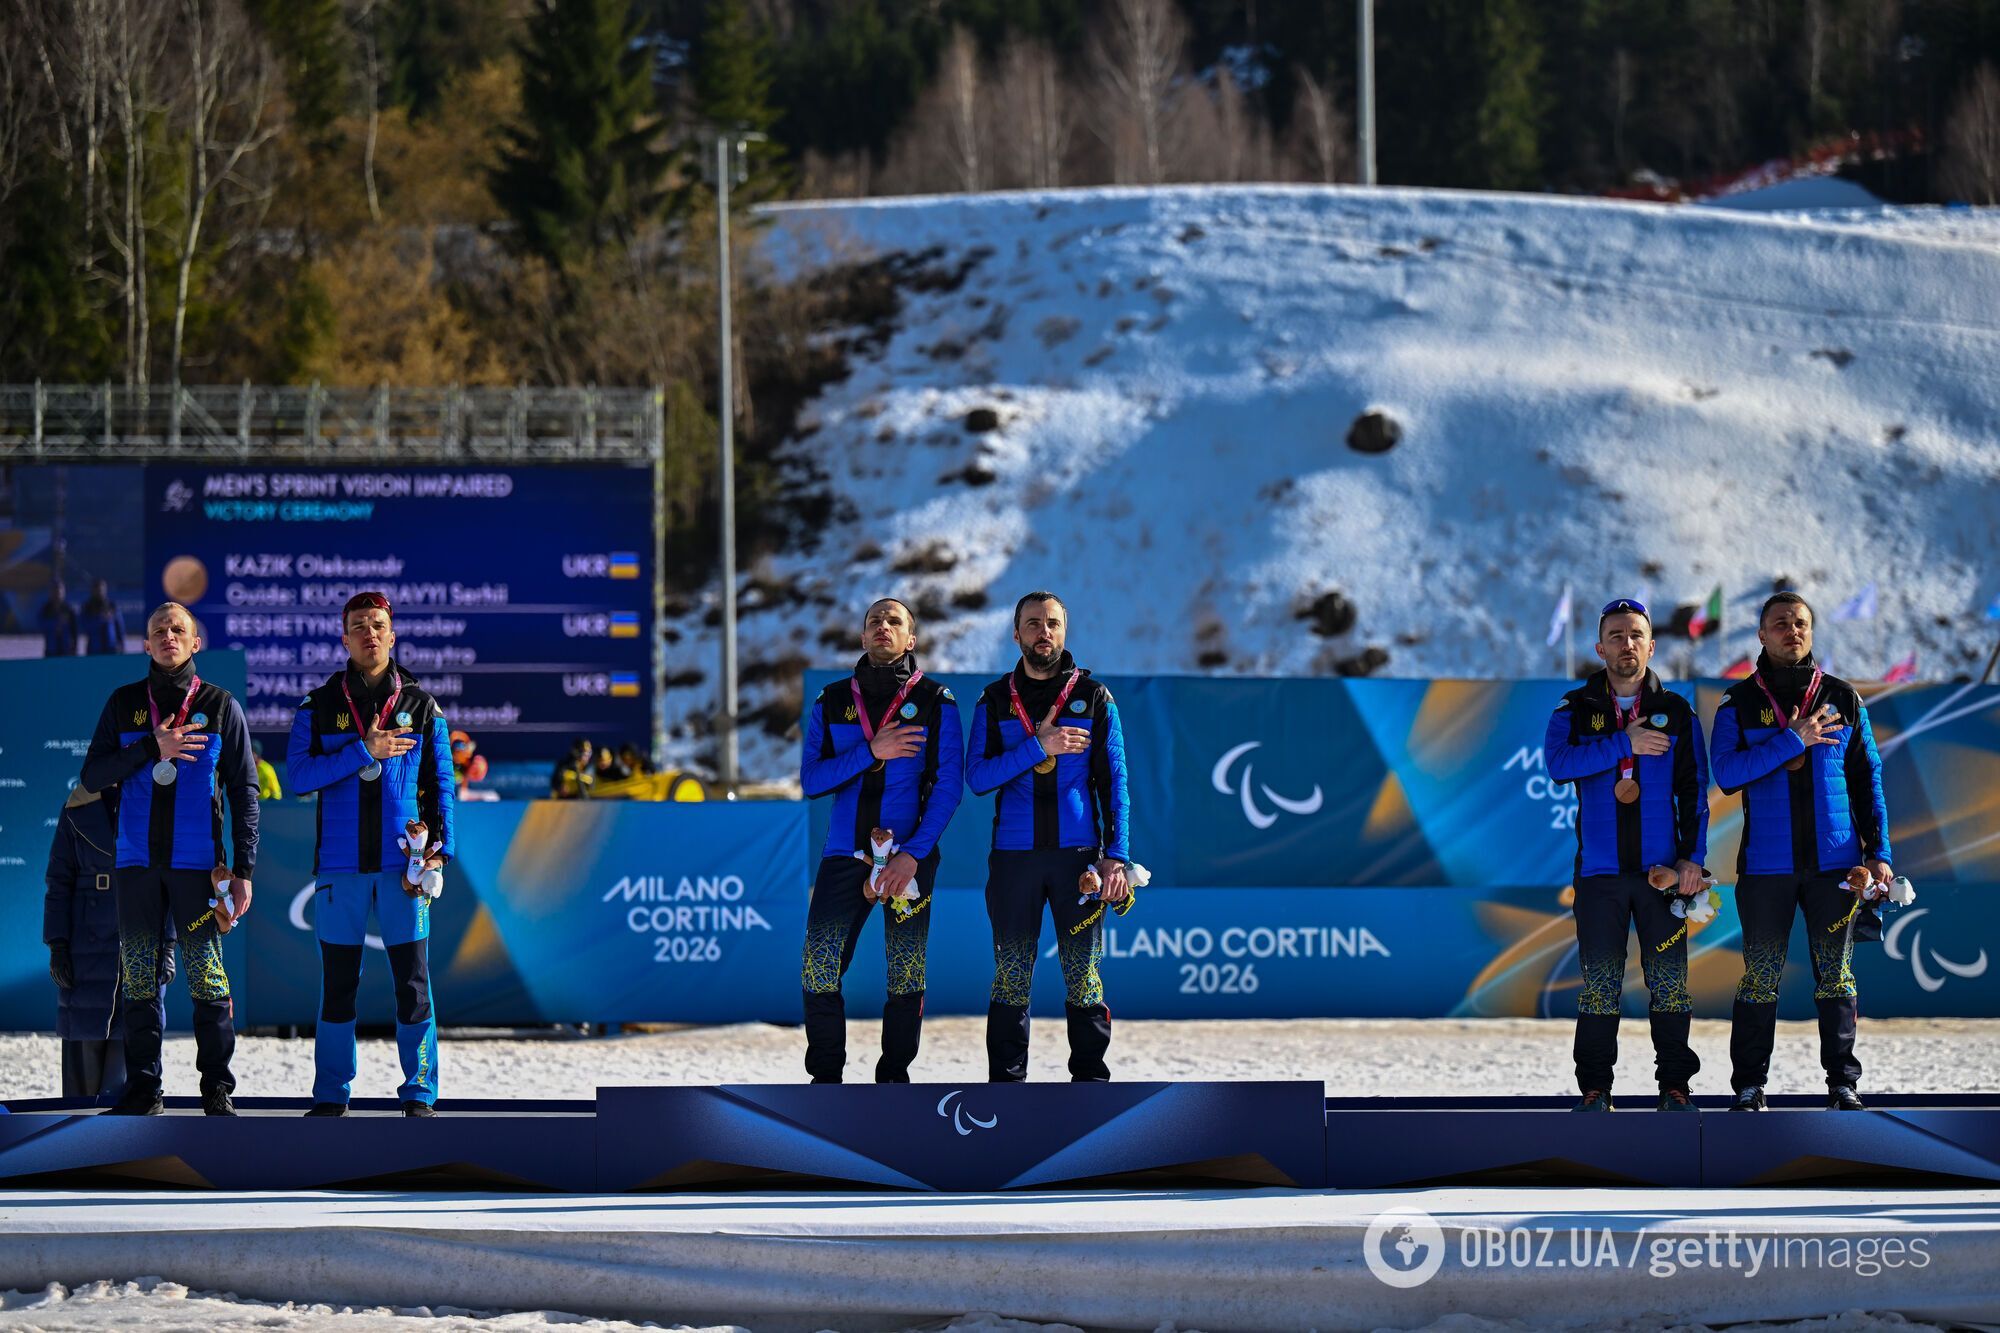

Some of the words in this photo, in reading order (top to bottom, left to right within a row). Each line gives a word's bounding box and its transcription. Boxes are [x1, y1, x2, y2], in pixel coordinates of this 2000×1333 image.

[203, 473, 268, 497] MEN'S
[269, 473, 338, 497] SPRINT
[339, 473, 411, 497] VISION
[412, 473, 513, 497] IMPAIRED
[203, 501, 277, 521] VICTORY
[278, 501, 375, 521] CEREMONY
[225, 553, 294, 577] KAZIK
[295, 553, 405, 578] Oleksandr
[562, 553, 608, 578] UKR
[226, 582, 297, 606] Guide:
[562, 613, 609, 637] UKR
[562, 673, 609, 697] UKR
[602, 875, 744, 902] MILANO
[627, 905, 772, 933] CORTINA
[653, 936, 721, 962] 2026
[1220, 927, 1391, 958] CORTINA
[1179, 963, 1259, 994] 2026
